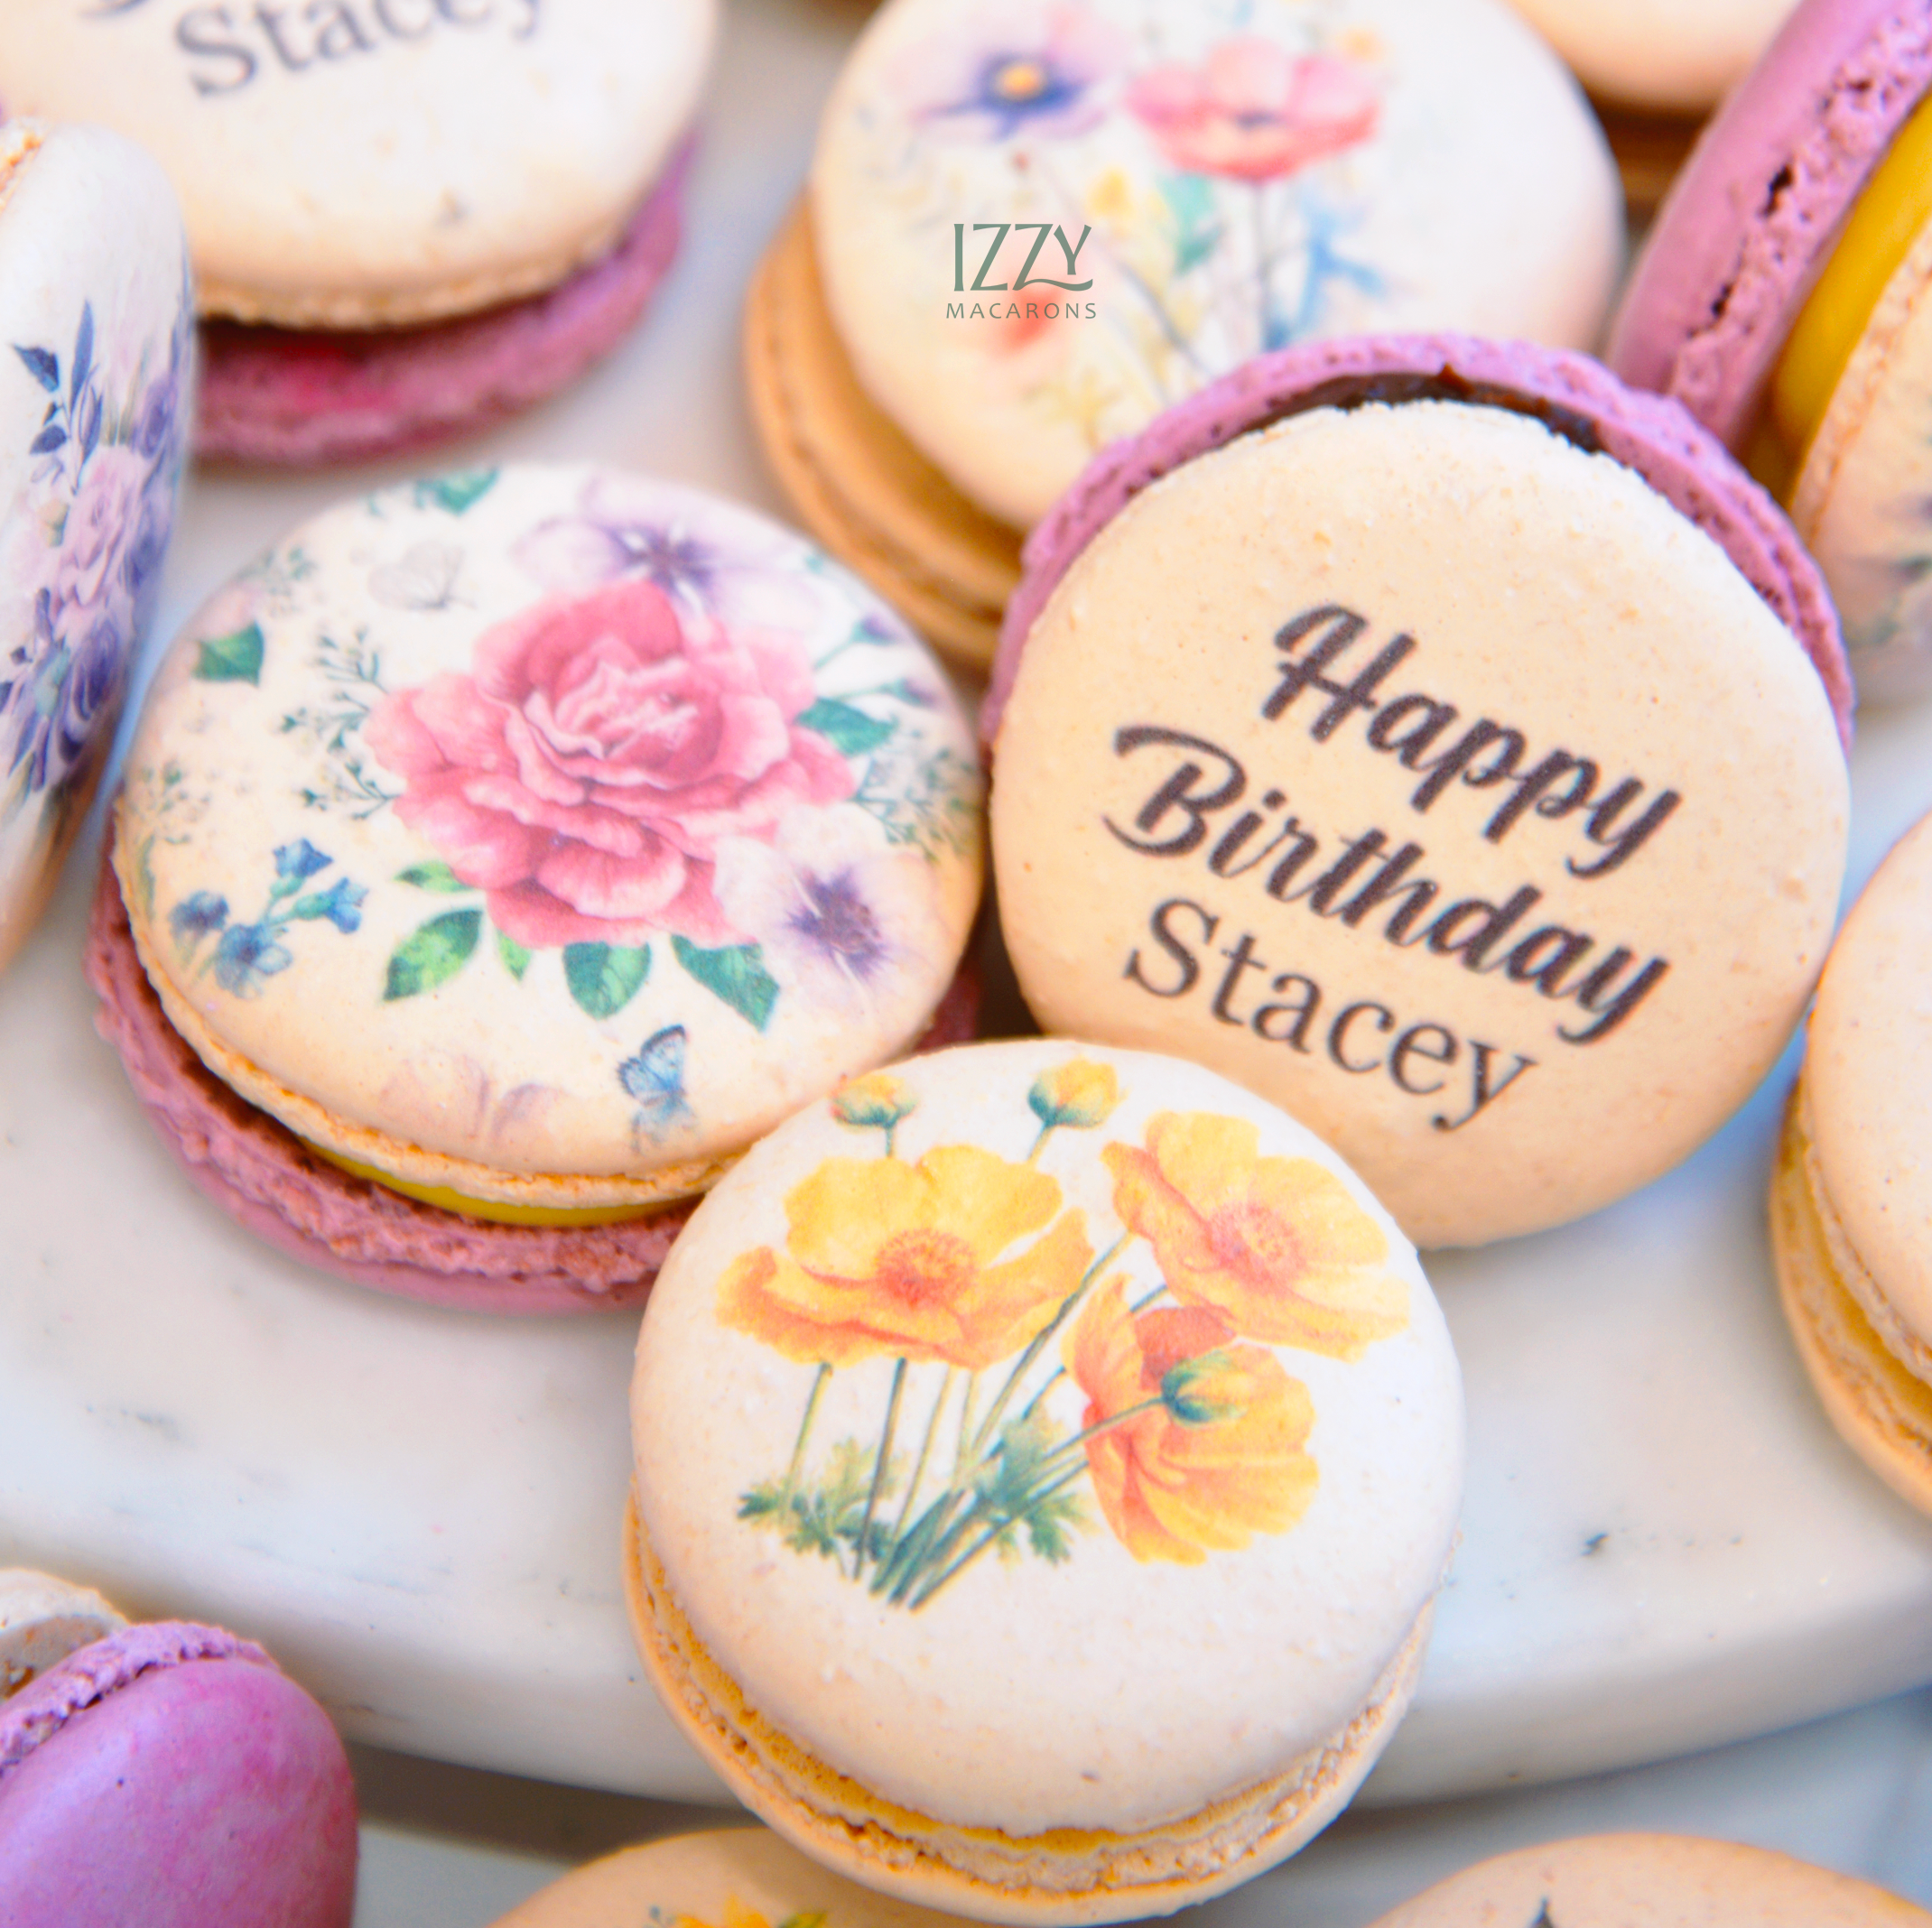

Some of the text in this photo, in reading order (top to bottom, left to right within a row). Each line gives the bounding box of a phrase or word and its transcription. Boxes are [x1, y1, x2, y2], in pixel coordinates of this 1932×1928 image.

[1261, 604, 1682, 879] Happy
[1101, 725, 1671, 1044] Birthday
[1122, 898, 1538, 1132] Stacey
